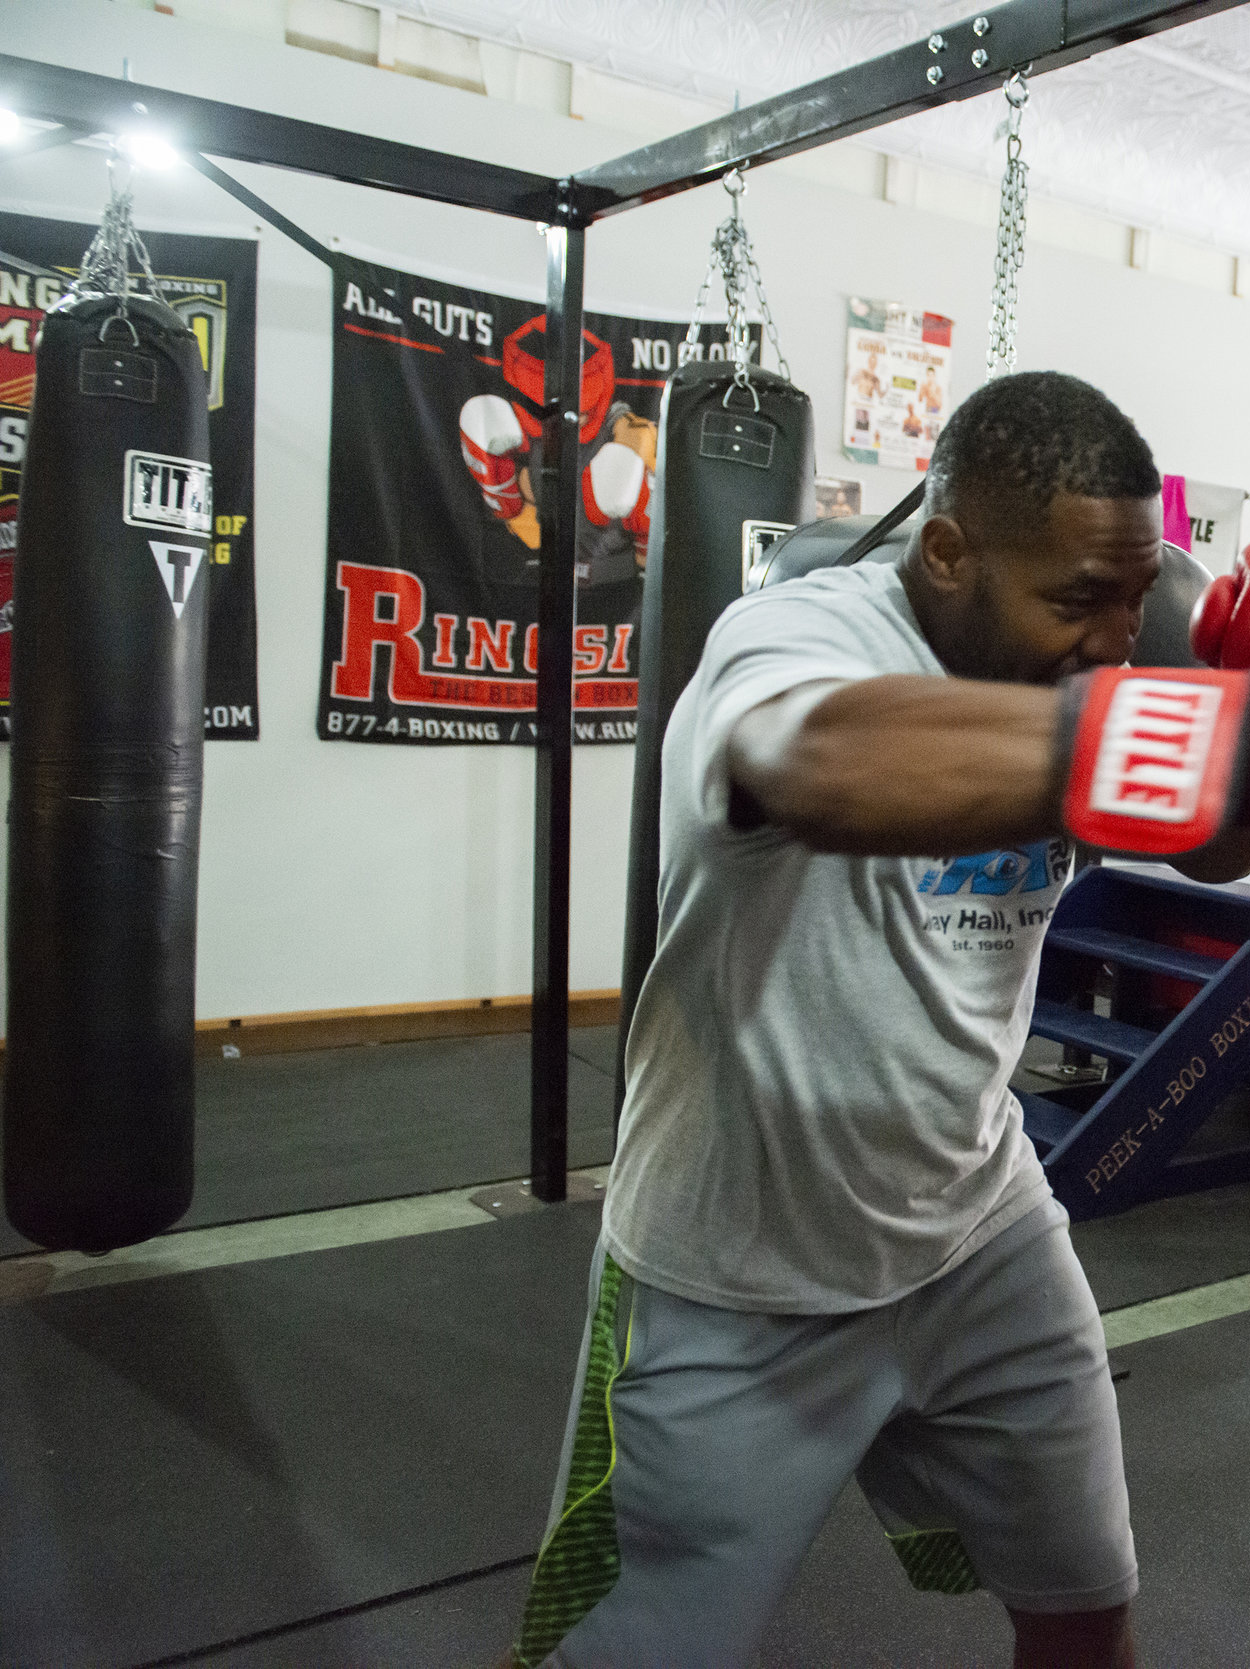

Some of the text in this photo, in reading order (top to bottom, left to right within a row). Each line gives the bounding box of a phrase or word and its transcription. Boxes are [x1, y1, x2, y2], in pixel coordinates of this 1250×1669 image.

[412, 296, 492, 346] GUTS
[632, 337, 671, 371] NO
[215, 515, 247, 535] OF
[167, 549, 191, 603] T
[327, 711, 499, 741] 877-4-BOXING
[1117, 690, 1202, 809] TITLE
[957, 909, 1012, 934] Hall,
[978, 938, 1014, 951] 1960
[1085, 1056, 1207, 1194] PEEK-A-BOO
